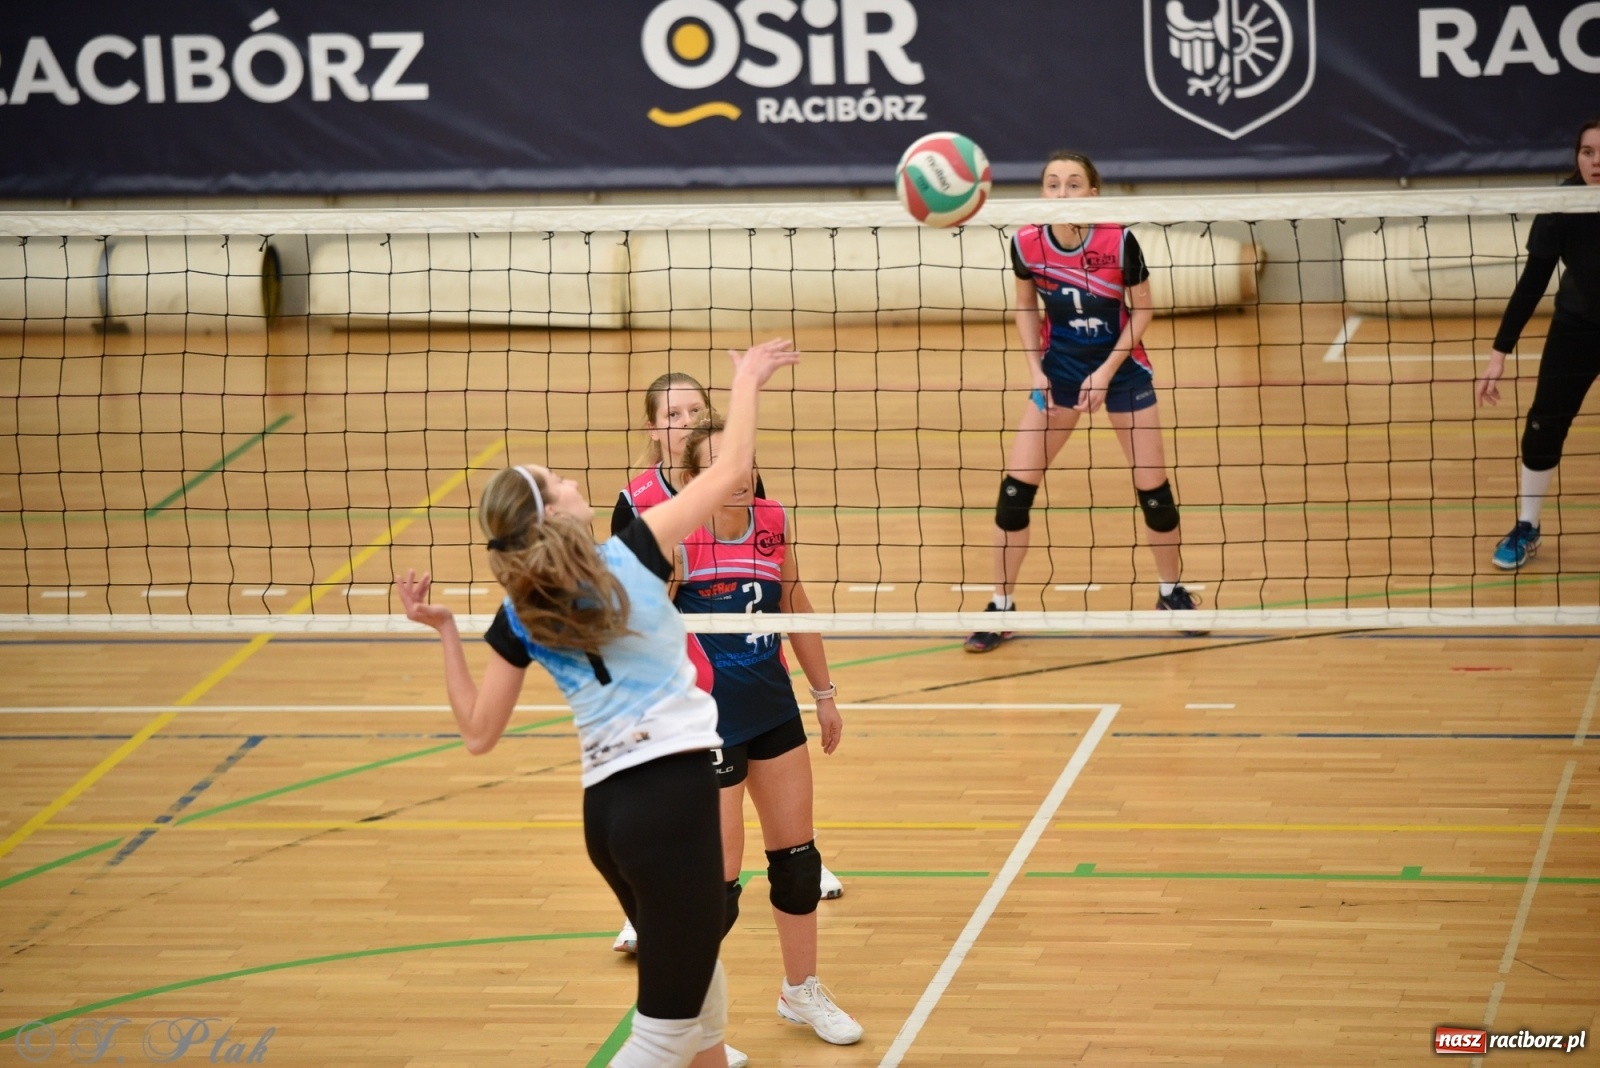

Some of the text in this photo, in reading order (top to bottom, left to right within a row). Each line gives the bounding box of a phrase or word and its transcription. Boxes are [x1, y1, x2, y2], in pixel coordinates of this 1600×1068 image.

[0, 8, 429, 105] ACIBÓRZ
[756, 88, 927, 123] RACIBÓRZ
[1061, 287, 1083, 314] 7
